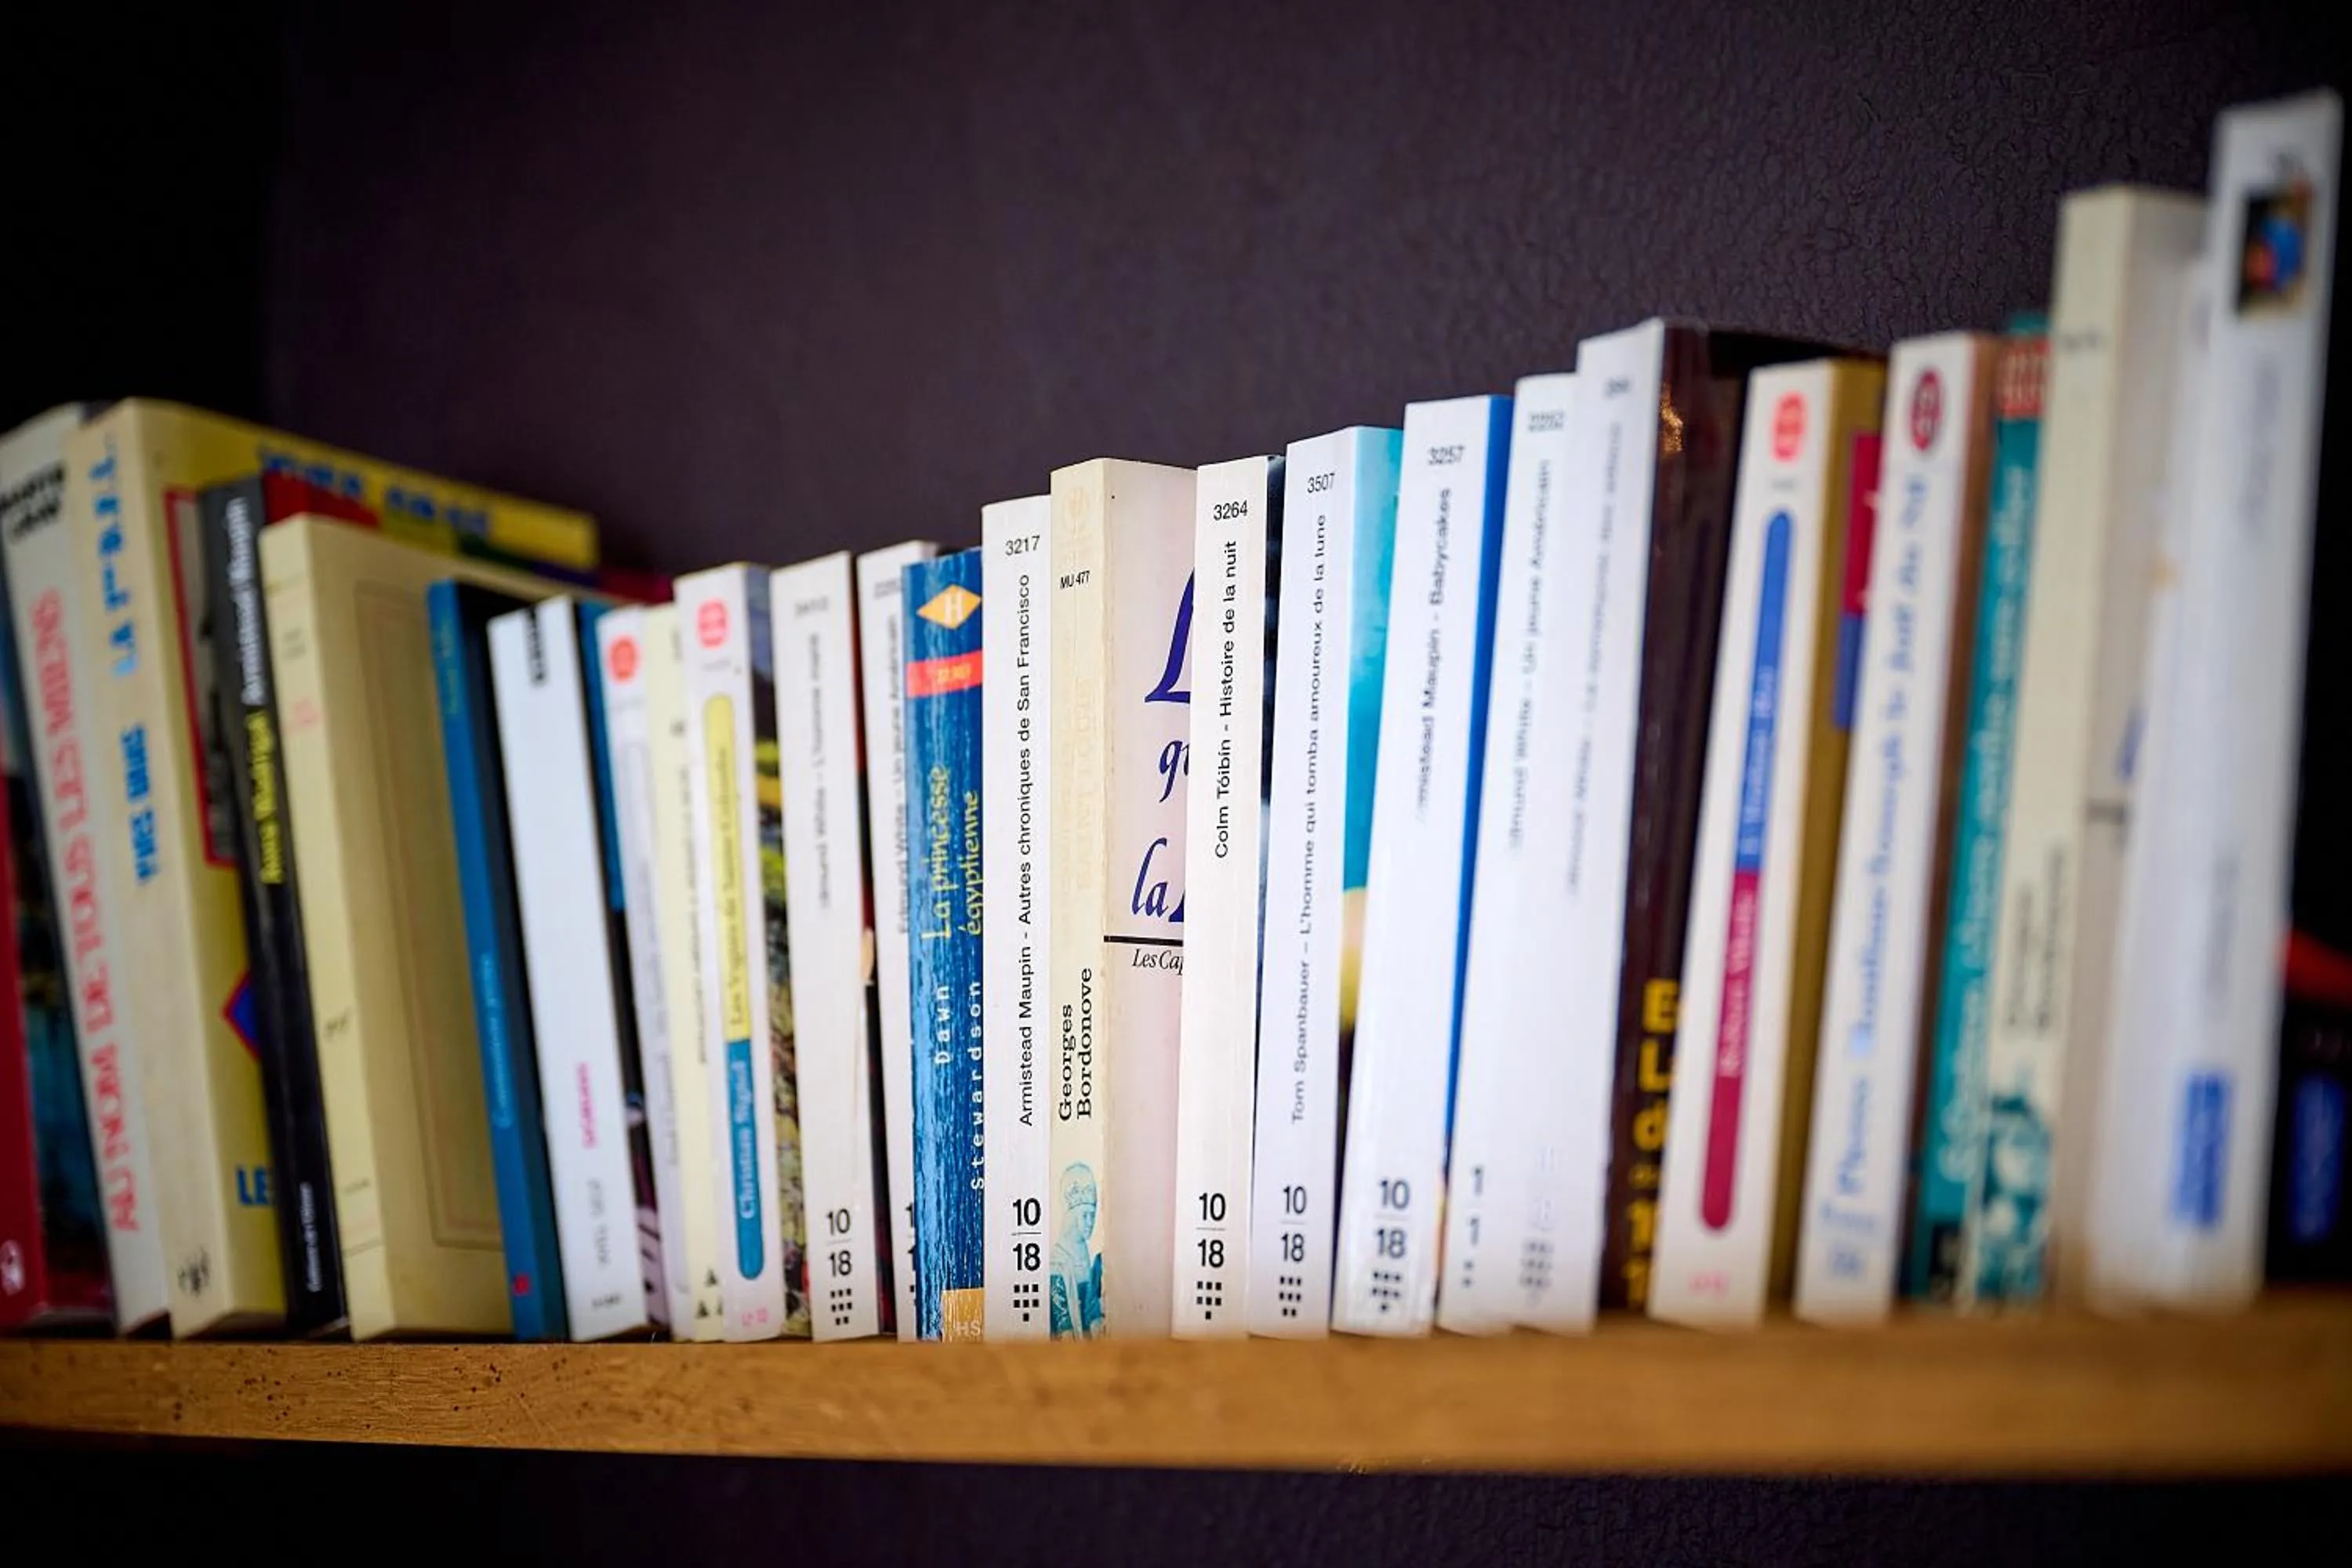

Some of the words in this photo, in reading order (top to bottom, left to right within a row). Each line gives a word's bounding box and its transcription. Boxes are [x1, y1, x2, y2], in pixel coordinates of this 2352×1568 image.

[1308, 473, 1335, 493] 3507
[1214, 501, 1249, 521] 3264
[1006, 535, 1040, 555] 3217
[1224, 540, 1237, 578] nuit
[1313, 514, 1326, 558] lune
[1428, 488, 1452, 606] Babycakes
[1060, 573, 1075, 589] MU
[1076, 571, 1091, 586] 477
[1222, 584, 1236, 603] la
[1312, 564, 1325, 582] la
[1016, 574, 1029, 669] Francisco
[1221, 608, 1236, 634] de
[1312, 588, 1324, 614] de
[1219, 640, 1235, 717] Histoire
[1310, 621, 1323, 722] amoureux
[1421, 628, 1441, 709] Maupin
[1017, 674, 1030, 712] San
[1017, 717, 1031, 742] de
[1216, 739, 1232, 800] Tóibín
[1305, 729, 1319, 795] tomba
[1415, 716, 1435, 822] rmistead
[1017, 747, 1034, 856] chroniques
[1305, 801, 1319, 833] qui
[925, 764, 960, 891] princesse
[1215, 805, 1229, 858] Colm
[957, 790, 984, 936] égyptienne
[1131, 837, 1169, 918] la
[1018, 862, 1032, 926] Autres
[1300, 840, 1314, 935] L'homme
[920, 901, 951, 939] La
[1131, 948, 1157, 968] Les
[82, 963, 114, 1033] DE
[1018, 946, 1035, 1019] Maupin
[935, 985, 953, 1065] Dawn
[1294, 960, 1310, 1073] Spanbauer
[1058, 1004, 1076, 1122] Georges
[1076, 967, 1092, 1120] Bordonove
[732, 1059, 753, 1123] Signol
[1019, 1026, 1033, 1127] Armistead
[91, 1043, 129, 1160] NOM
[1291, 1080, 1305, 1123] Tom
[739, 1128, 756, 1220] Christian
[1380, 1180, 1410, 1210] 10
[111, 1167, 140, 1233] AU
[827, 1209, 851, 1235] 10
[1012, 1198, 1040, 1227] 10
[1199, 1192, 1226, 1221] 10
[1283, 1185, 1306, 1214] 10
[829, 1250, 852, 1277] 18
[1012, 1243, 1040, 1272] 18
[1197, 1240, 1225, 1269] 18
[1280, 1234, 1305, 1262] 18
[1377, 1229, 1406, 1259] 18
